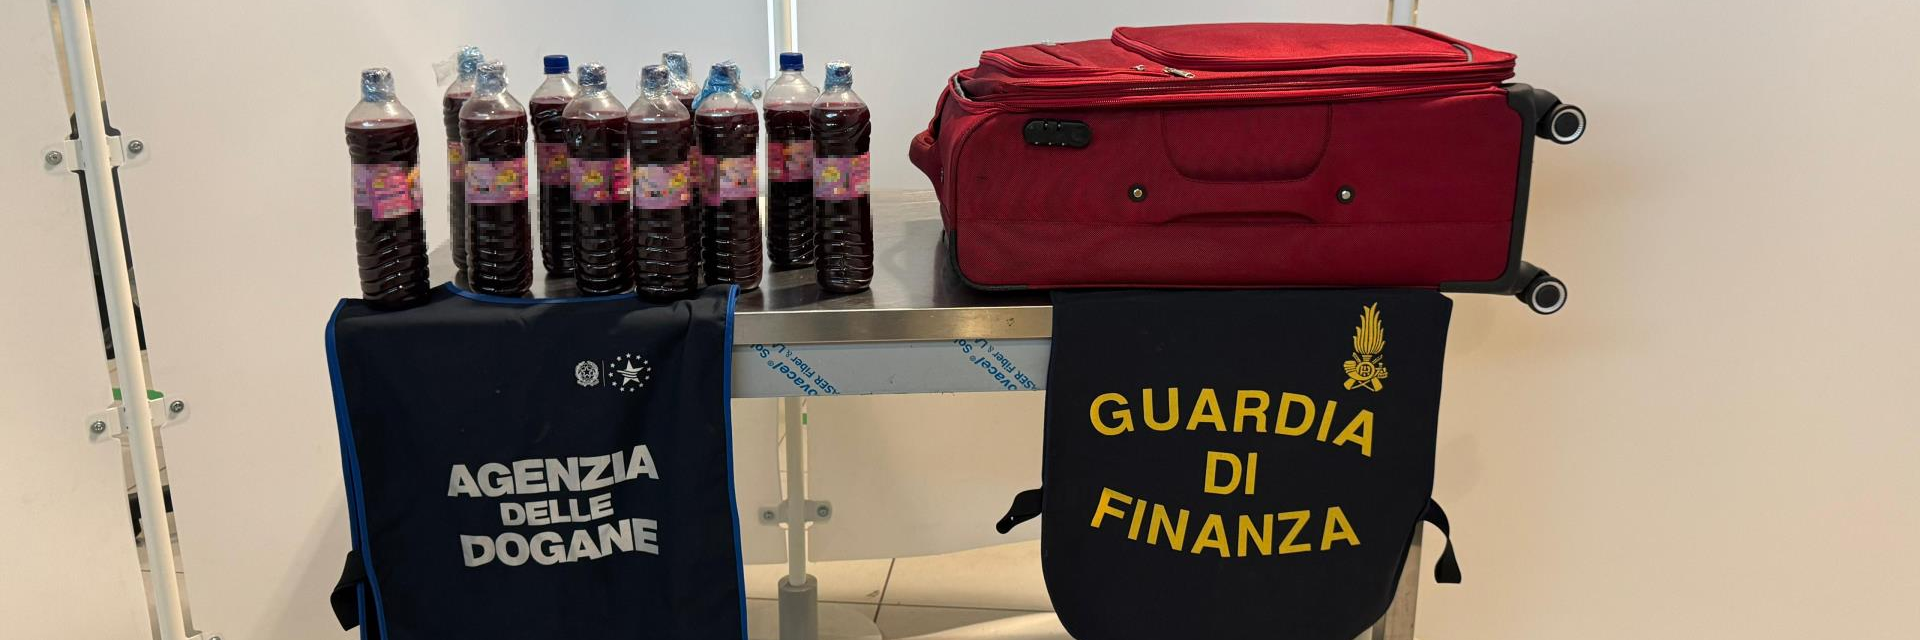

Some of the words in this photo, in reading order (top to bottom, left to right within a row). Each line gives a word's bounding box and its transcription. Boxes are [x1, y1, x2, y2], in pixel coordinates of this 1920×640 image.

[790, 356, 816, 379] Fiber
[991, 351, 1017, 374] Fiber
[1089, 387, 1375, 458] GUARDIA
[447, 444, 660, 499] AGENZIA
[1203, 450, 1258, 496] DI
[499, 492, 615, 527] DELLE
[1090, 487, 1361, 558] FINANZA
[459, 517, 660, 568] DOGANE
